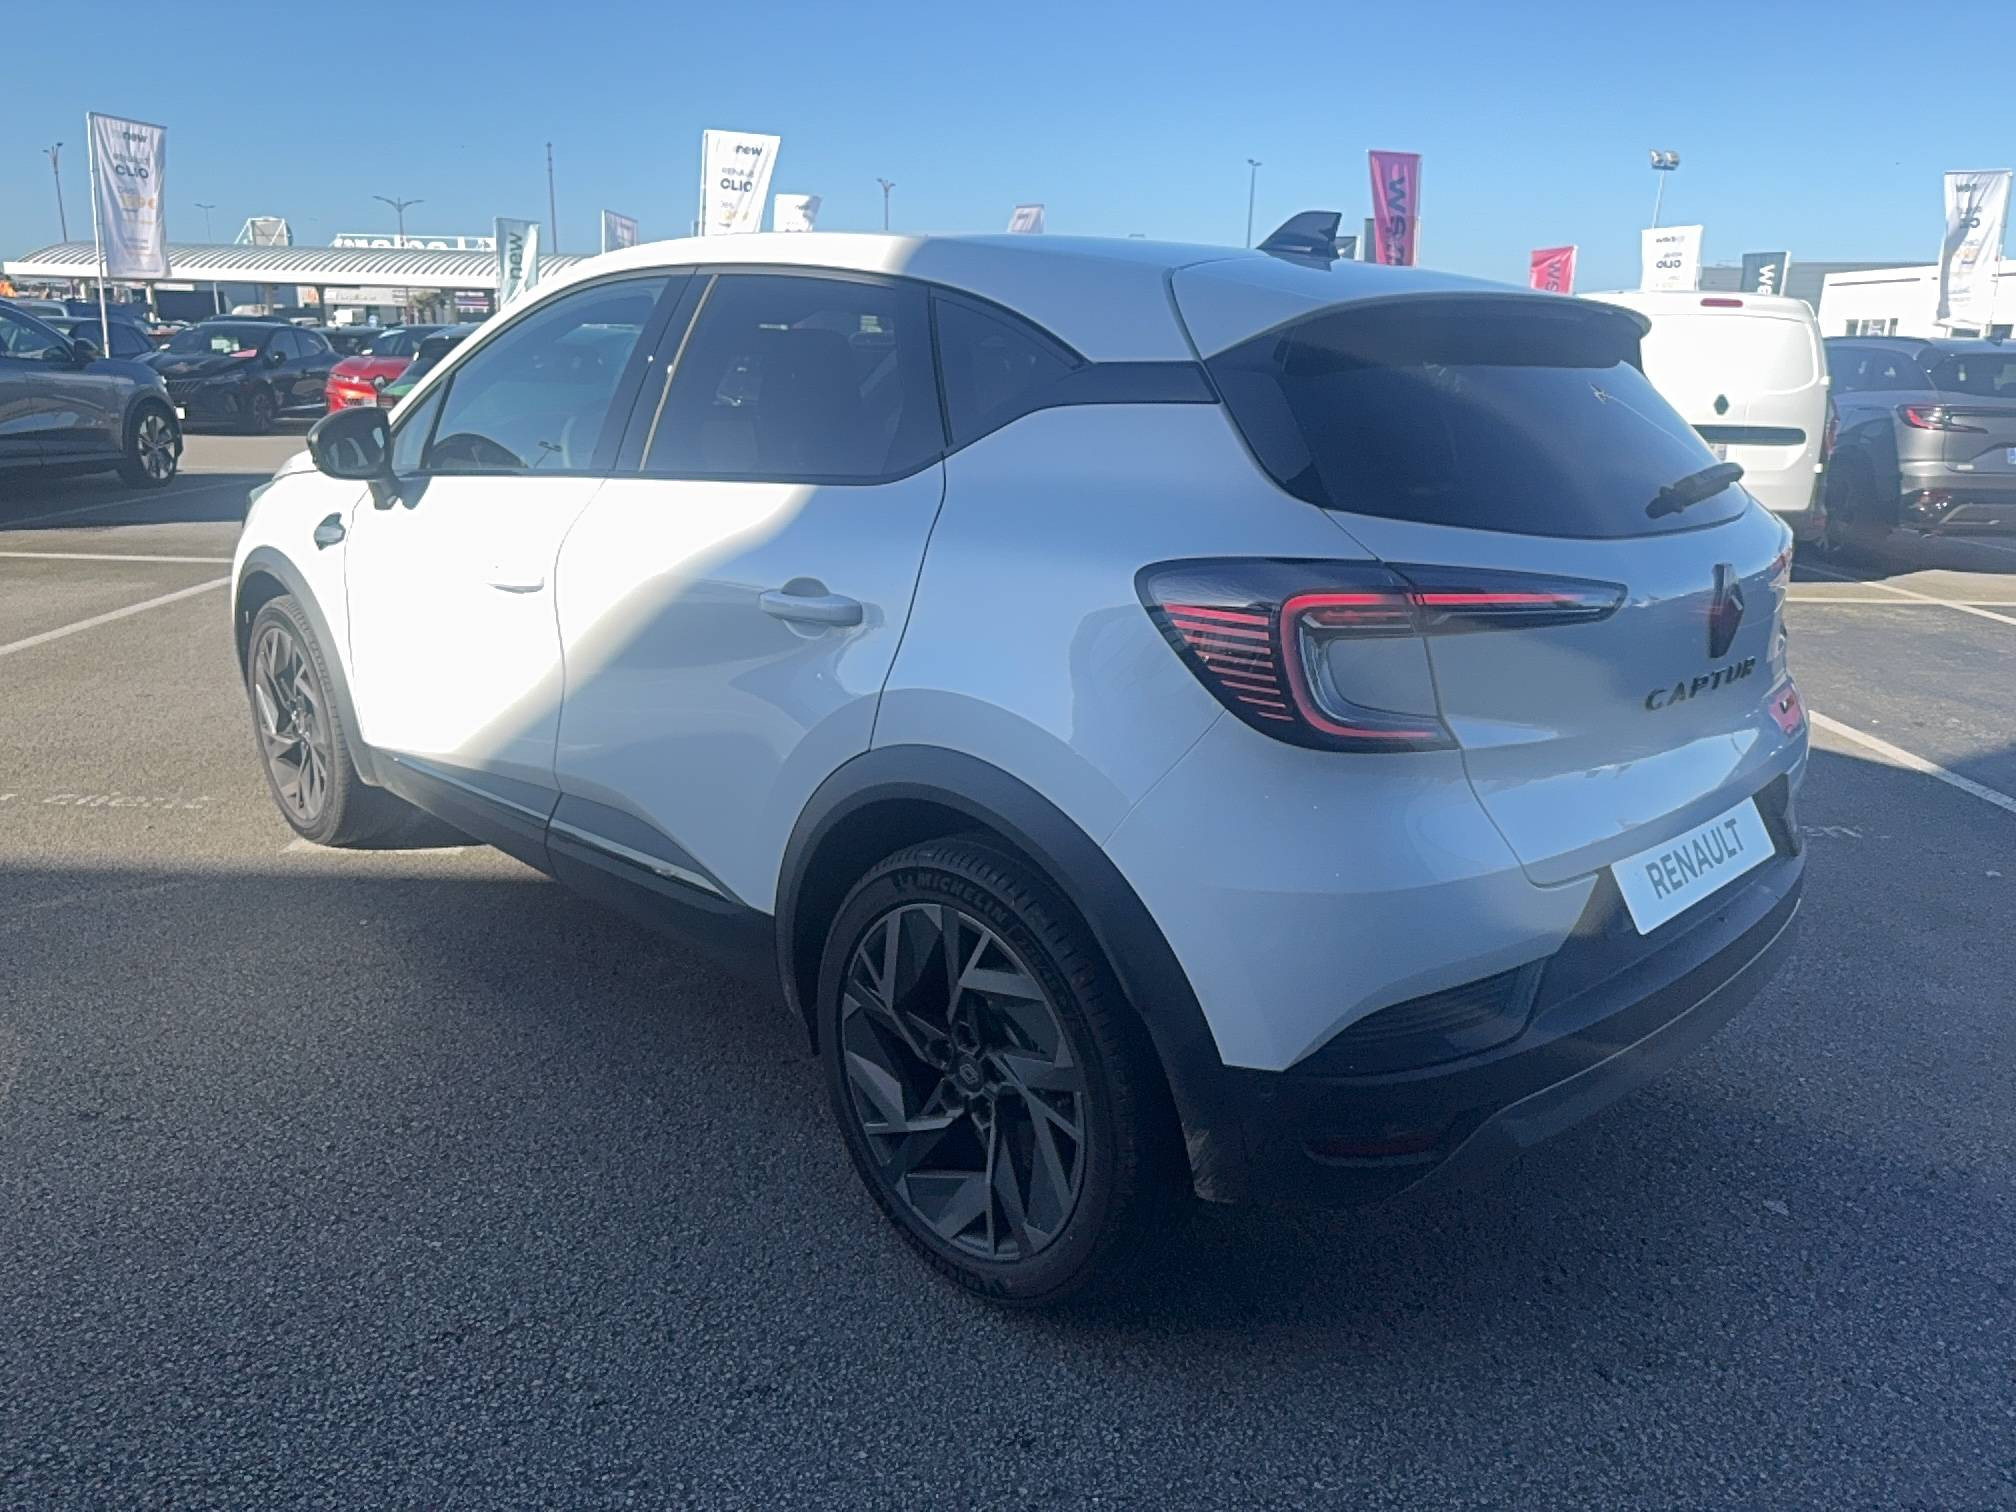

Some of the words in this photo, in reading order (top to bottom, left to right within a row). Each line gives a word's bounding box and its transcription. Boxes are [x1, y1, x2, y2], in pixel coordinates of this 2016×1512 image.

[115, 164, 150, 179] CLIO
[735, 145, 762, 156] new
[720, 178, 752, 192] CLIO
[510, 232, 523, 279] new
[1645, 656, 1756, 711] CAPTUR
[1645, 817, 1745, 900] RENAULT
[916, 871, 1009, 929] MICHELIN
